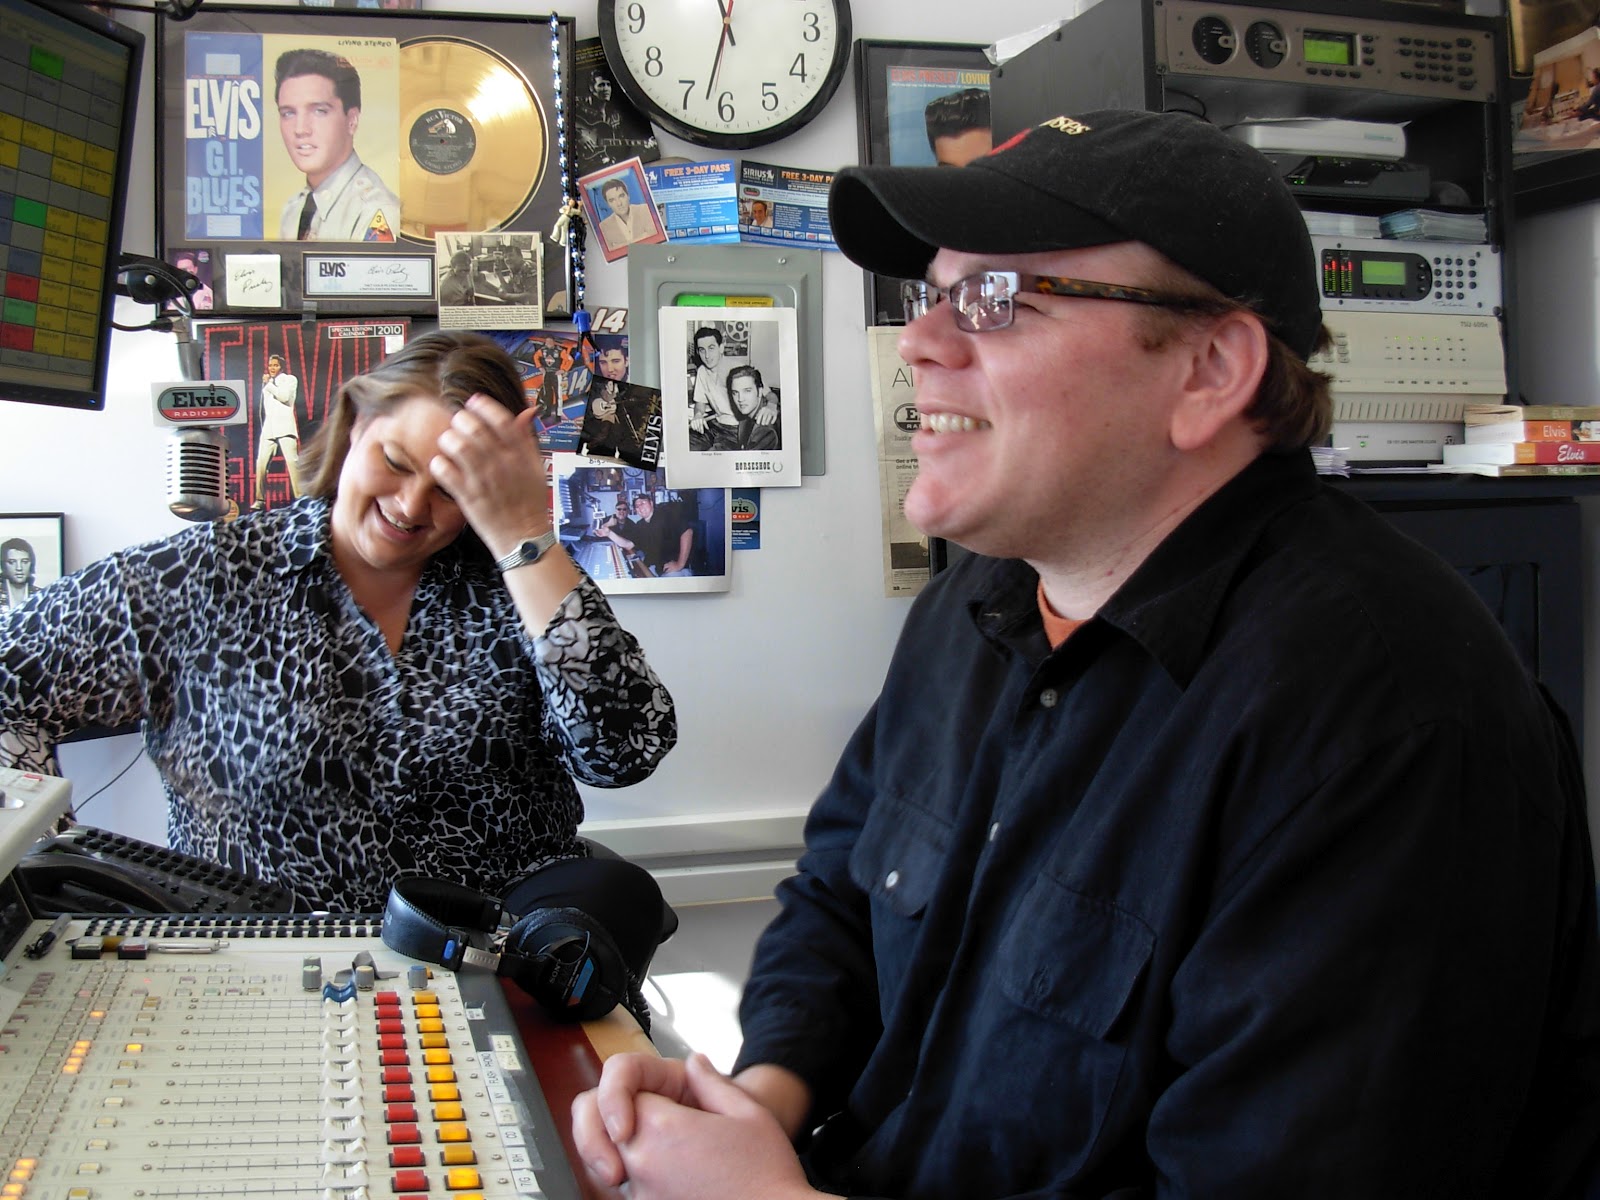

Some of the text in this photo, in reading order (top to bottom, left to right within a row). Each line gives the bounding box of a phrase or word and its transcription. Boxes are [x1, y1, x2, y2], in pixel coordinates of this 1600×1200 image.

[627, 3, 645, 34] 9
[803, 12, 820, 42] 3
[644, 46, 663, 77] 8
[789, 53, 807, 83] 4
[891, 69, 916, 82] ELVIS
[918, 70, 957, 84] PRESLEY
[679, 80, 695, 110] 7
[718, 91, 735, 122] 6
[762, 82, 778, 111] 5
[186, 79, 261, 139] ELVIS
[206, 141, 243, 176] G.I.
[664, 163, 731, 177] FREE 3-DAY PASS
[743, 167, 766, 178] SIRIUS
[781, 171, 800, 180] FREE
[801, 173, 824, 182] 3-DAY
[187, 176, 260, 215] BLUES
[376, 215, 382, 223] 3
[319, 261, 346, 277] ELVIS
[377, 326, 401, 335] 2010
[591, 307, 627, 333] 14
[568, 368, 589, 395] 14
[172, 391, 228, 408] Elvis
[641, 414, 662, 464] ELVIS
[1543, 425, 1566, 438] Elvis
[735, 462, 771, 470] HORSESHOE
[1557, 444, 1585, 462] Elvis
[732, 503, 749, 513] vis
